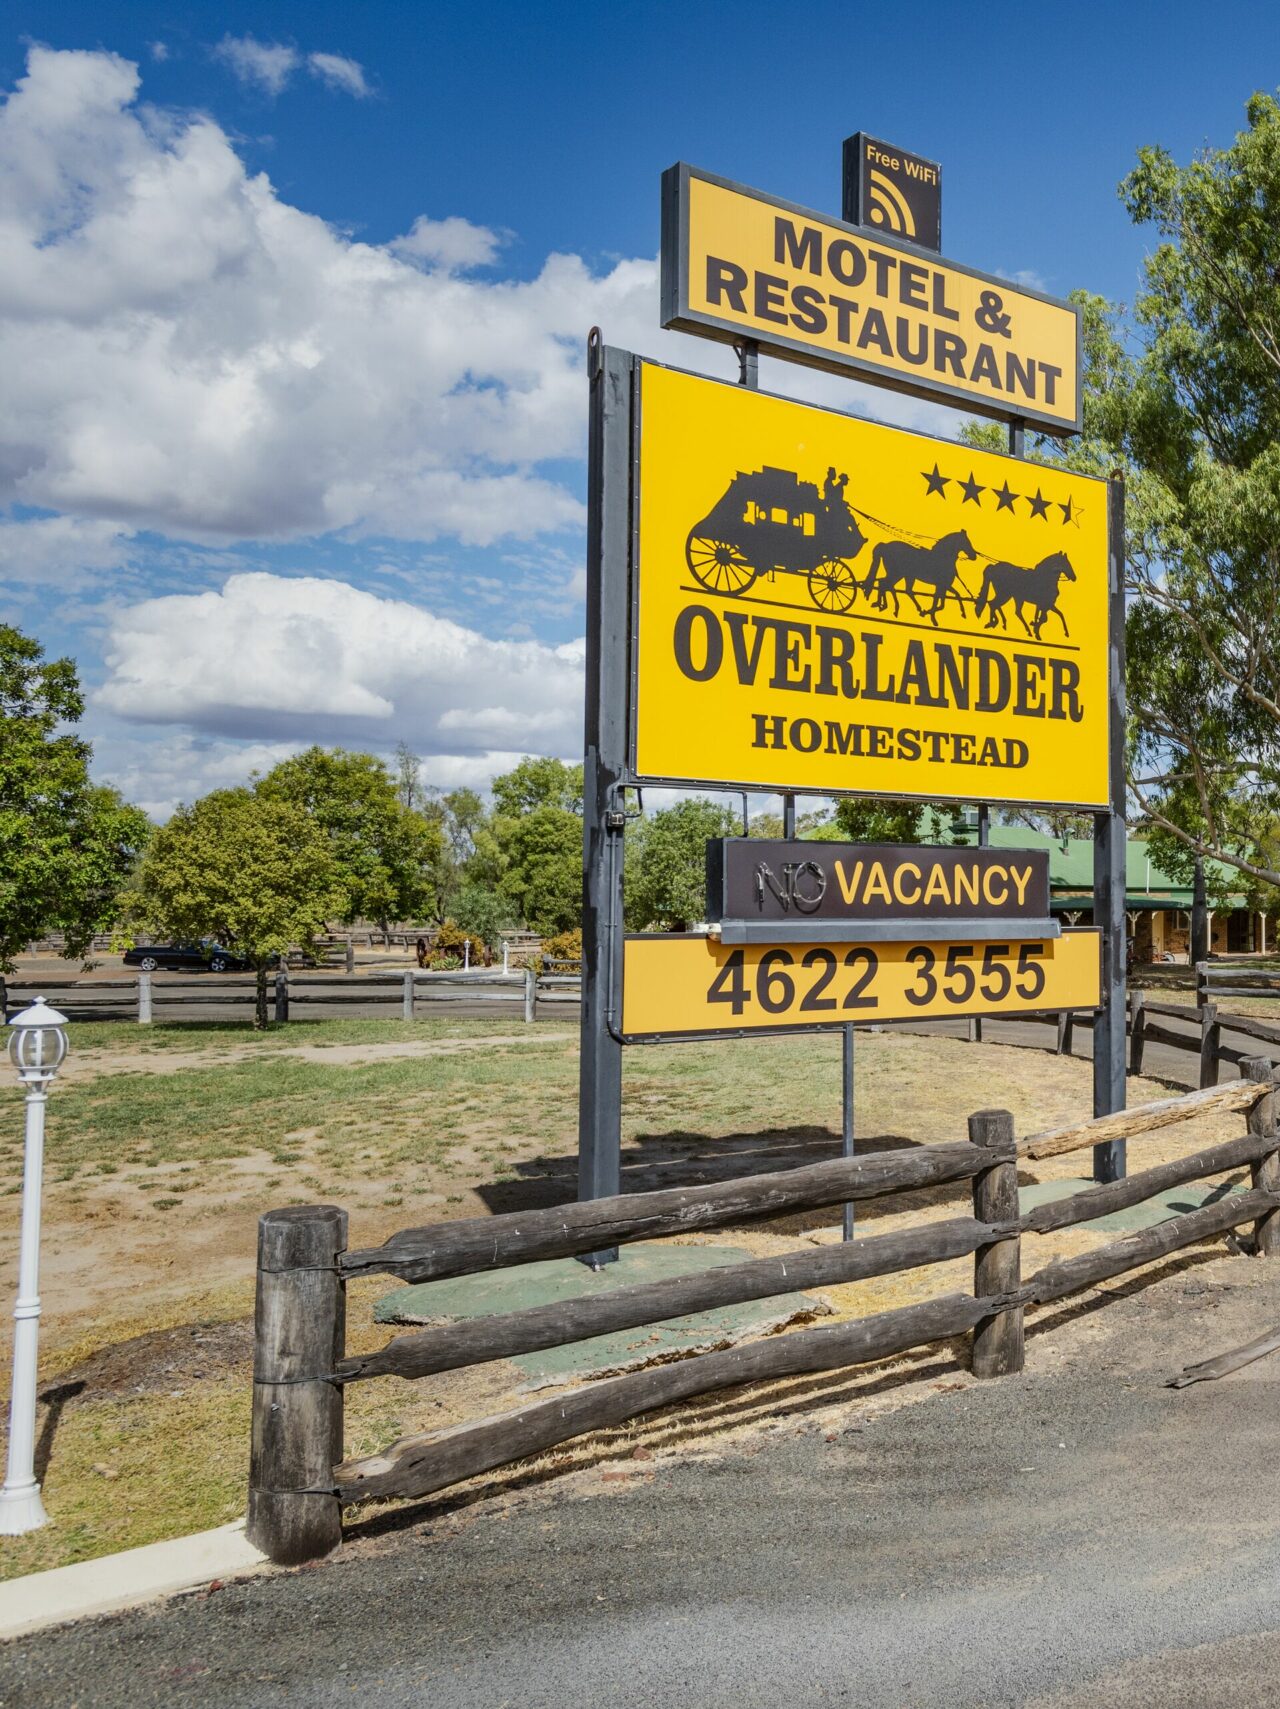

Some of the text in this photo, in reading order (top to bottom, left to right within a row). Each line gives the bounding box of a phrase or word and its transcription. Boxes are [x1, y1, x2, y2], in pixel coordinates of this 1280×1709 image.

[866, 145, 937, 186] Free WiFi
[774, 216, 1013, 339] MOTEL &
[706, 255, 1063, 405] RESTAURANT
[673, 604, 1085, 723] OVERLANDER
[751, 713, 1030, 769] HOMESTEAD
[755, 860, 1033, 908] NO VACANCY
[706, 943, 1046, 1016] 4622 3555
